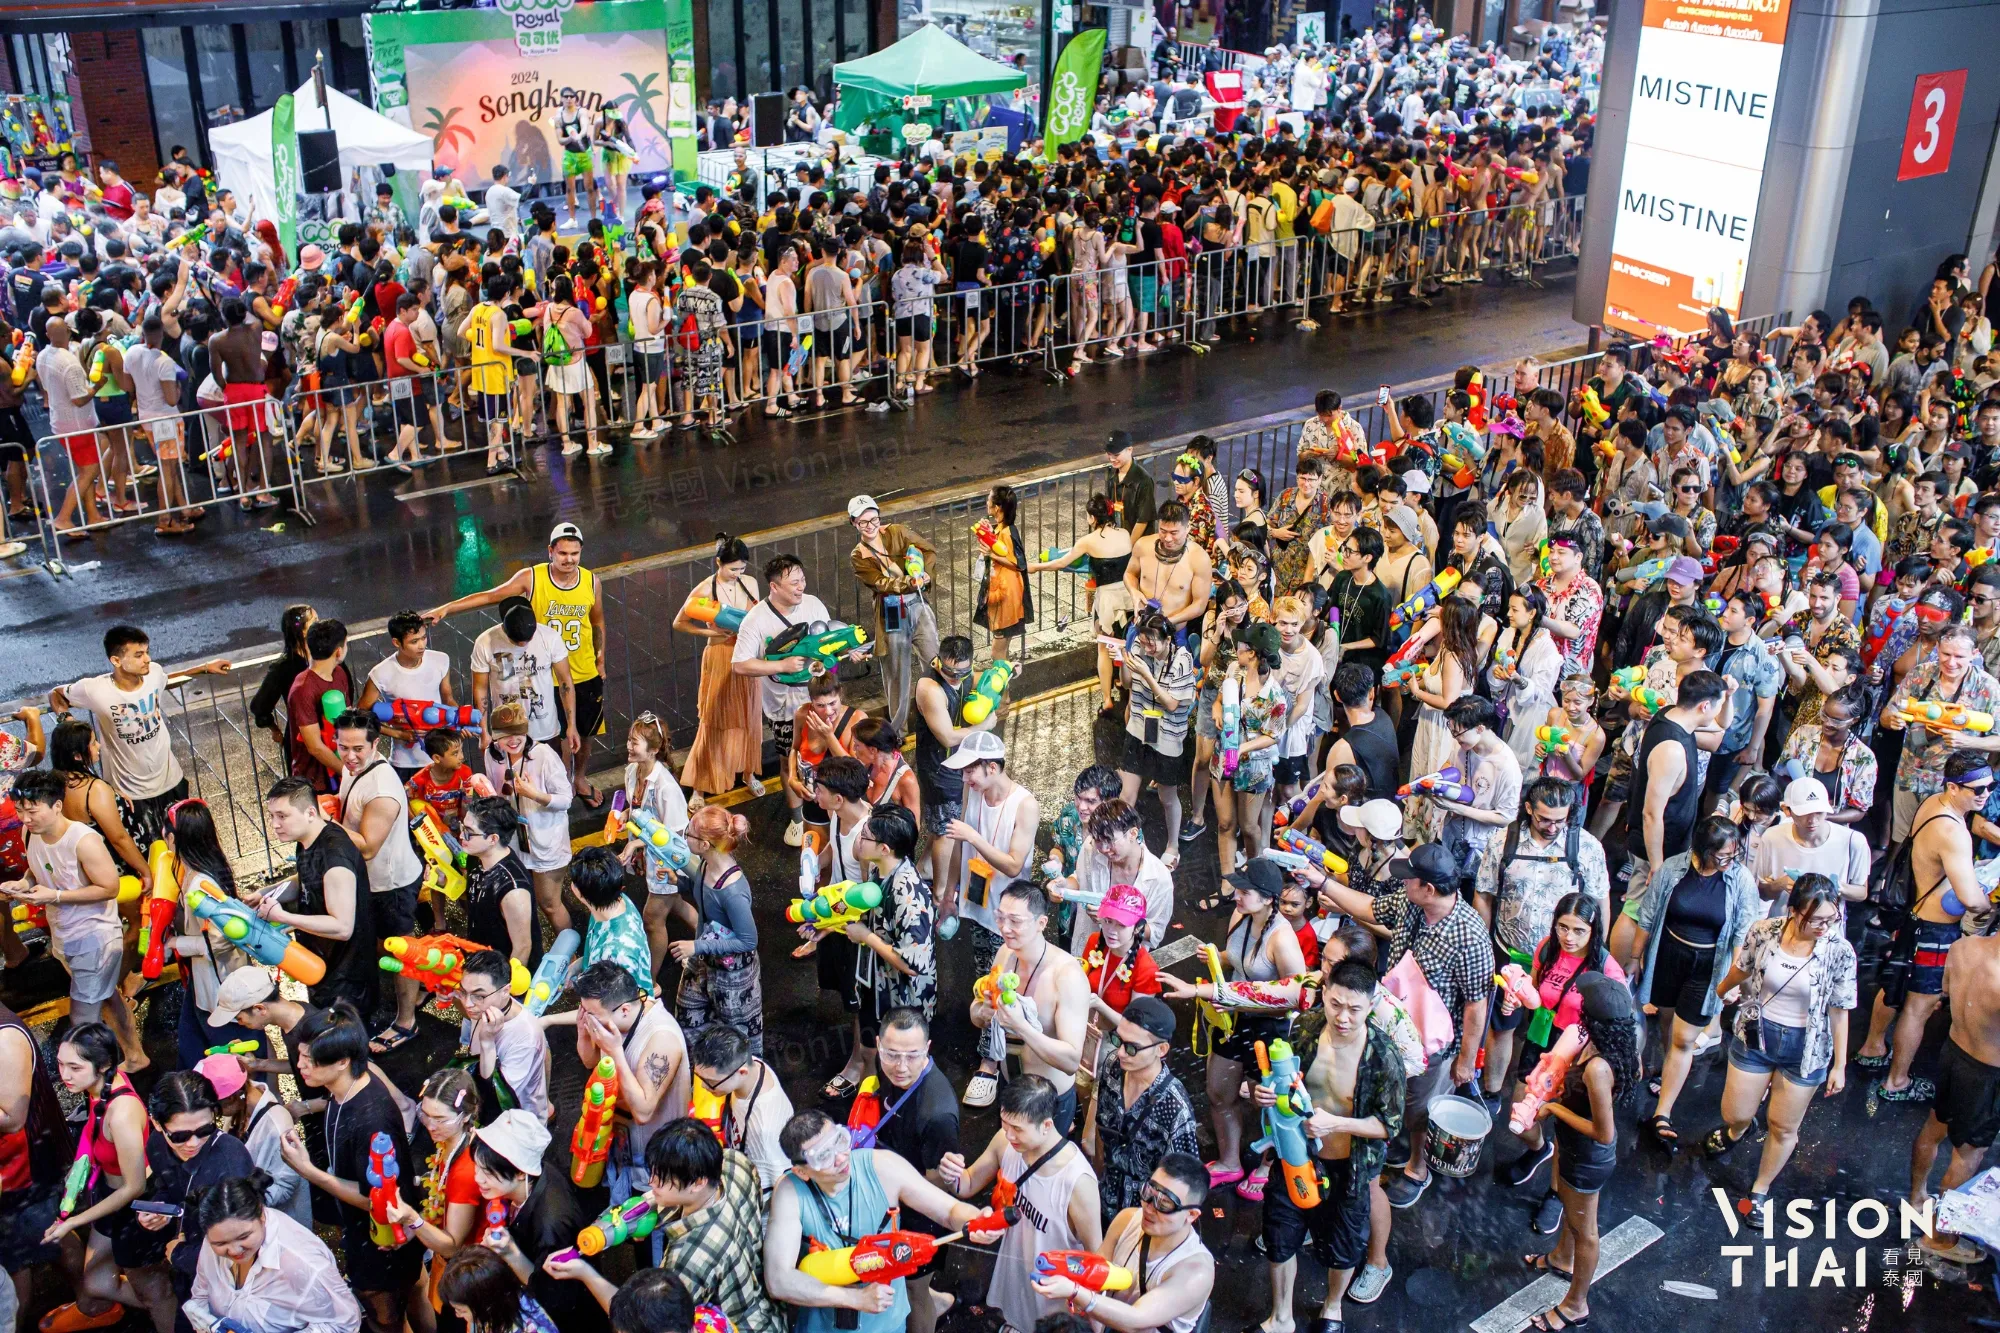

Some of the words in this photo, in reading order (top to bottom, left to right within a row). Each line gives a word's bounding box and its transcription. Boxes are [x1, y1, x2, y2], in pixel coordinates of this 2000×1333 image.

[515, 8, 560, 28] Royal
[511, 71, 539, 85] 2024
[1639, 75, 1769, 119] MISTINE
[479, 80, 603, 123] Songkan
[1071, 87, 1087, 127] Royal
[1913, 87, 1946, 164] 3
[1624, 189, 1748, 241] MISTINE
[1612, 260, 1670, 287] SUNSCREEN
